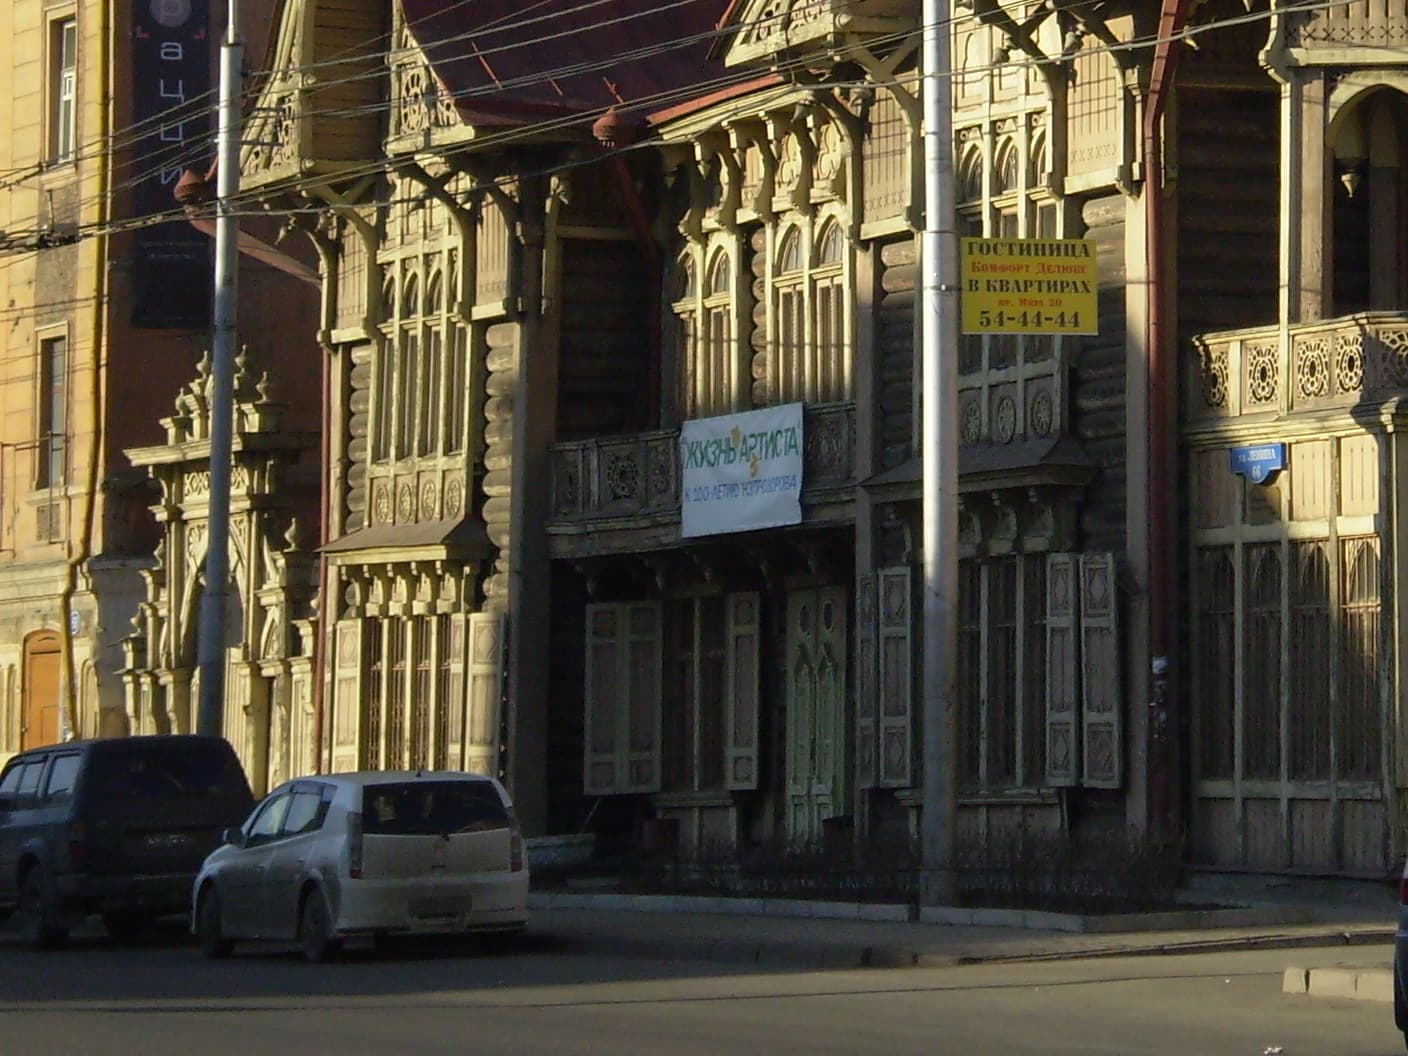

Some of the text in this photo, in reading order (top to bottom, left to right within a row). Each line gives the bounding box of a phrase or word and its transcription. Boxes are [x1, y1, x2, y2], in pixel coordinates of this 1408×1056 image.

[967, 241, 1091, 258] ГОСТИНИЦА
[968, 279, 1091, 293] В КВАРТИРАХ
[979, 310, 1081, 328] 54-44-44
